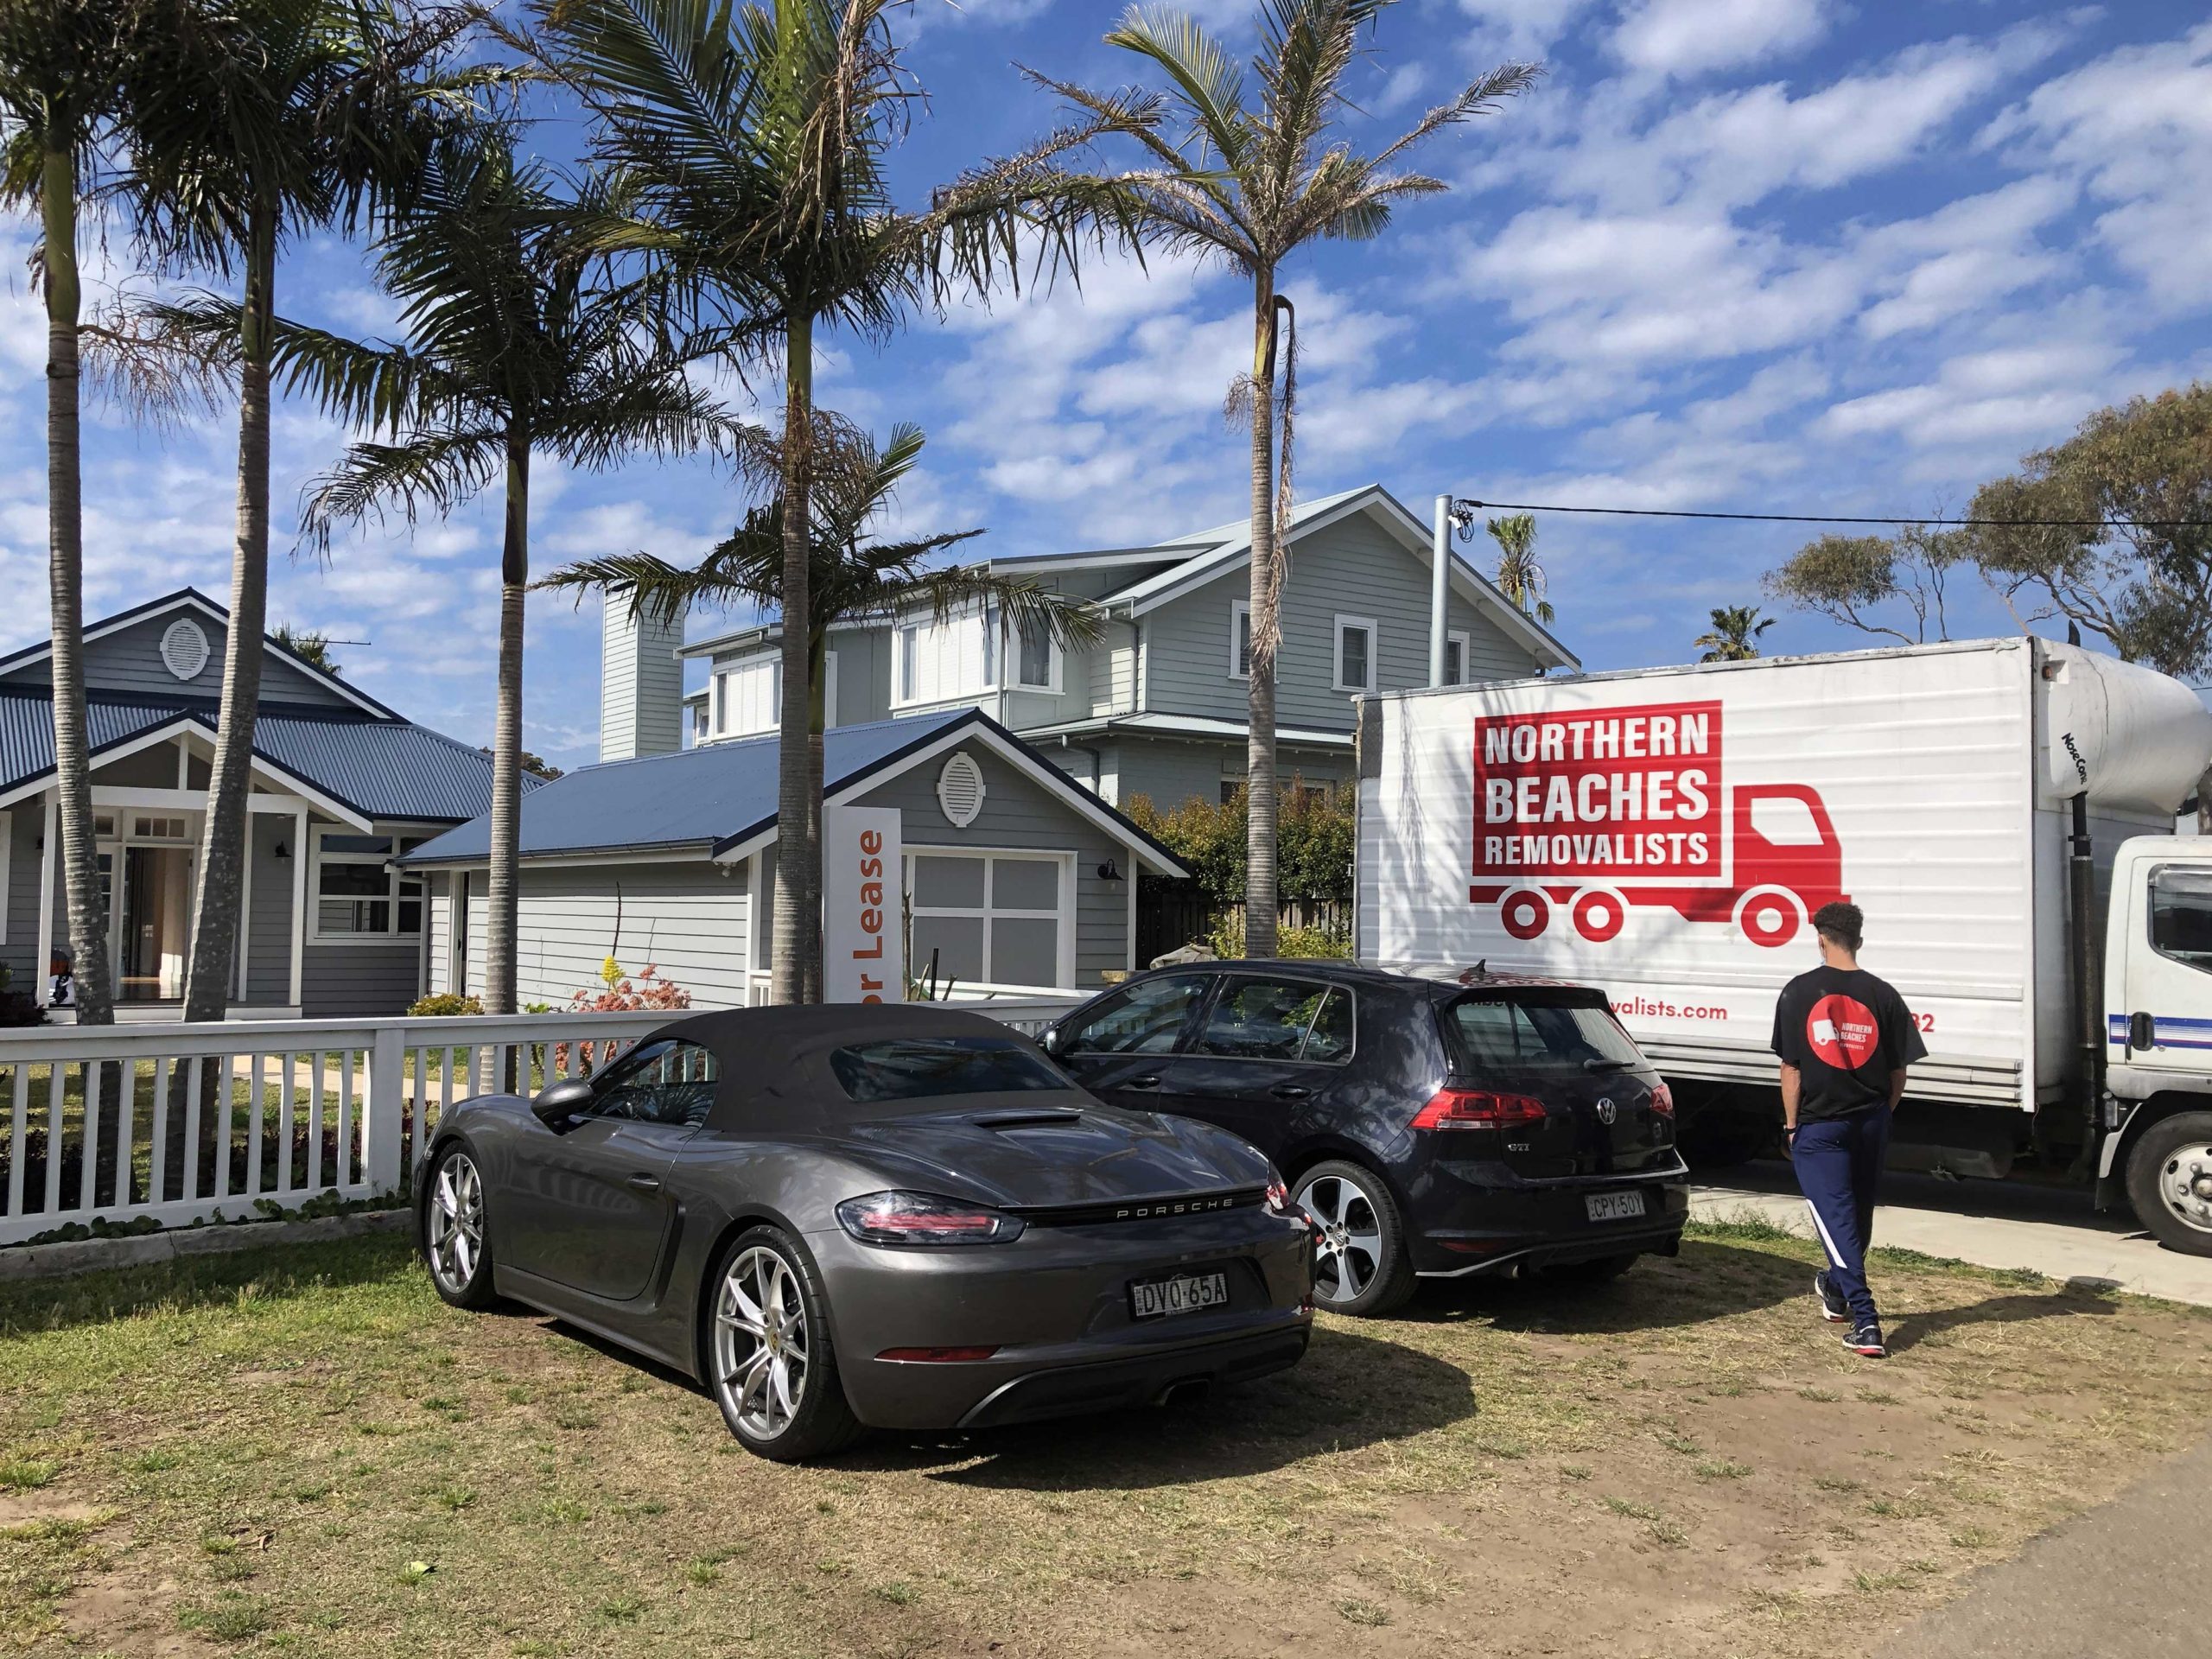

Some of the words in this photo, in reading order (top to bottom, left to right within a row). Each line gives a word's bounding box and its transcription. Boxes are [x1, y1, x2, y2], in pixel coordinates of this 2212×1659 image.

[1484, 713, 1709, 765] NORTHERN
[1484, 768, 1709, 823] BEACHES
[1484, 831, 1709, 865] REMOVALISTS
[853, 830, 883, 959] Lease
[1116, 1198, 1233, 1219] PORSCHE
